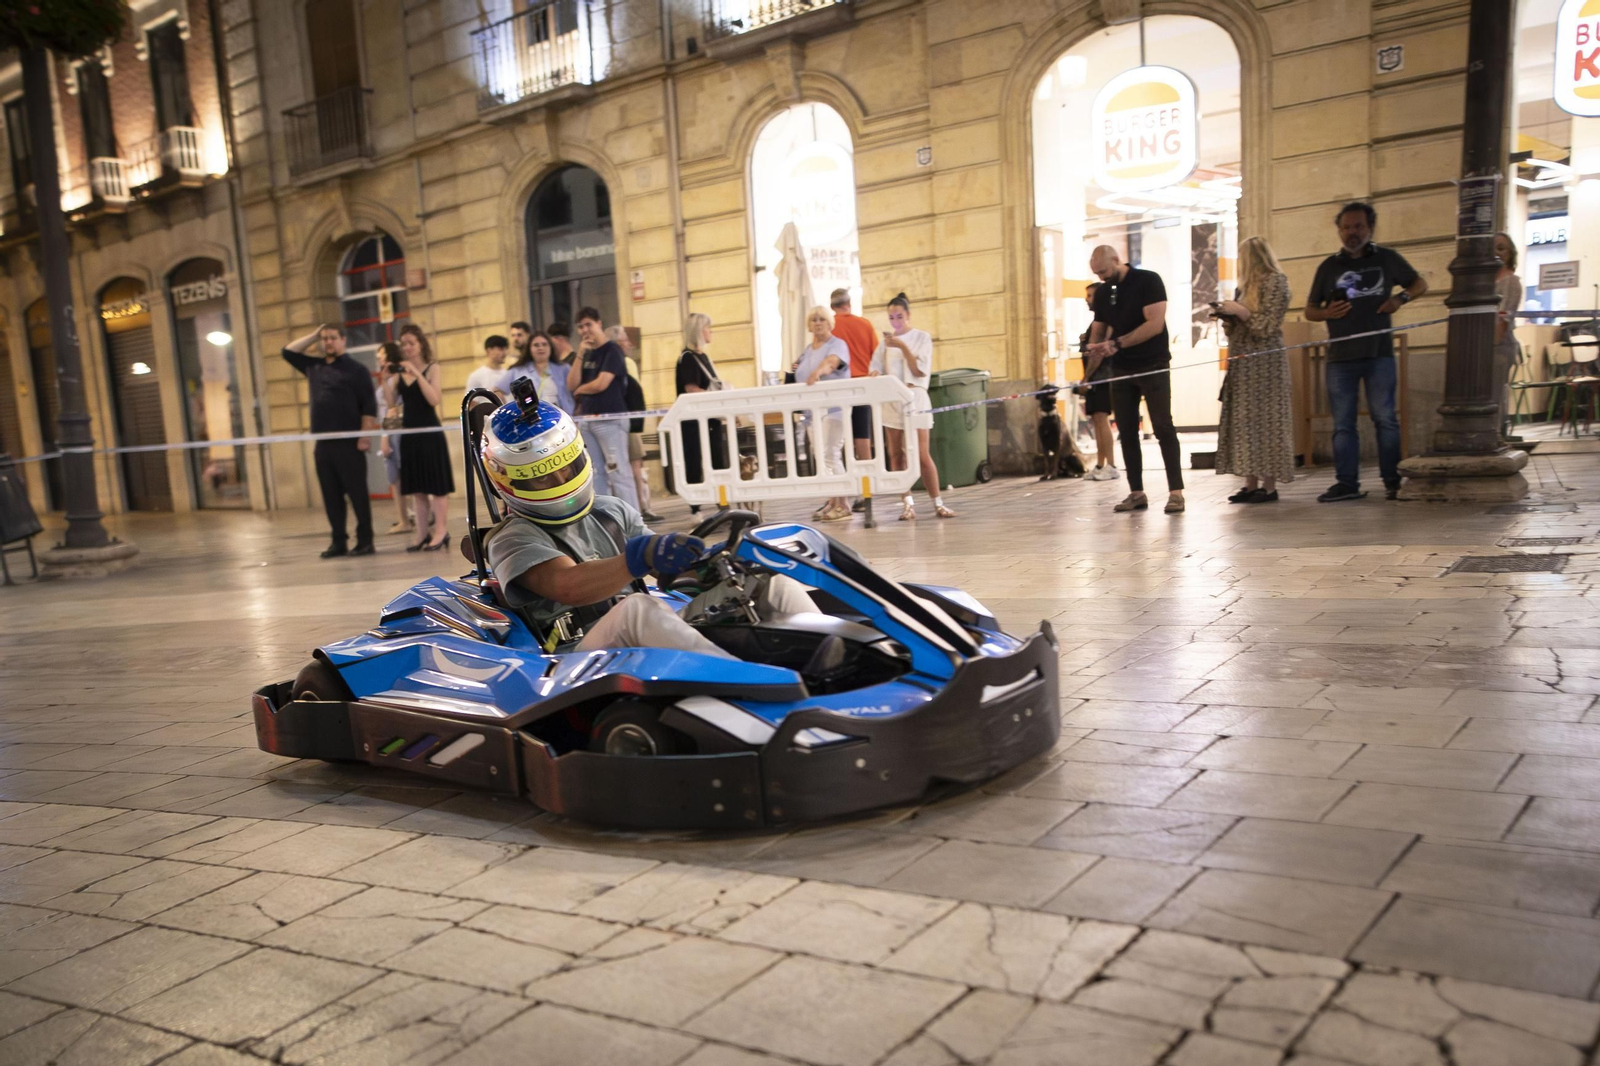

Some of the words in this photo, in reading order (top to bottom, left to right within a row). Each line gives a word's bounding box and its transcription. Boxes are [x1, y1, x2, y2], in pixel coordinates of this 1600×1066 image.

[1104, 108, 1181, 136] BURGER
[1105, 129, 1181, 164] KING
[810, 248, 845, 264] HOME
[811, 265, 825, 279] OF
[828, 266, 850, 280] THE
[530, 454, 562, 478] FOTO
